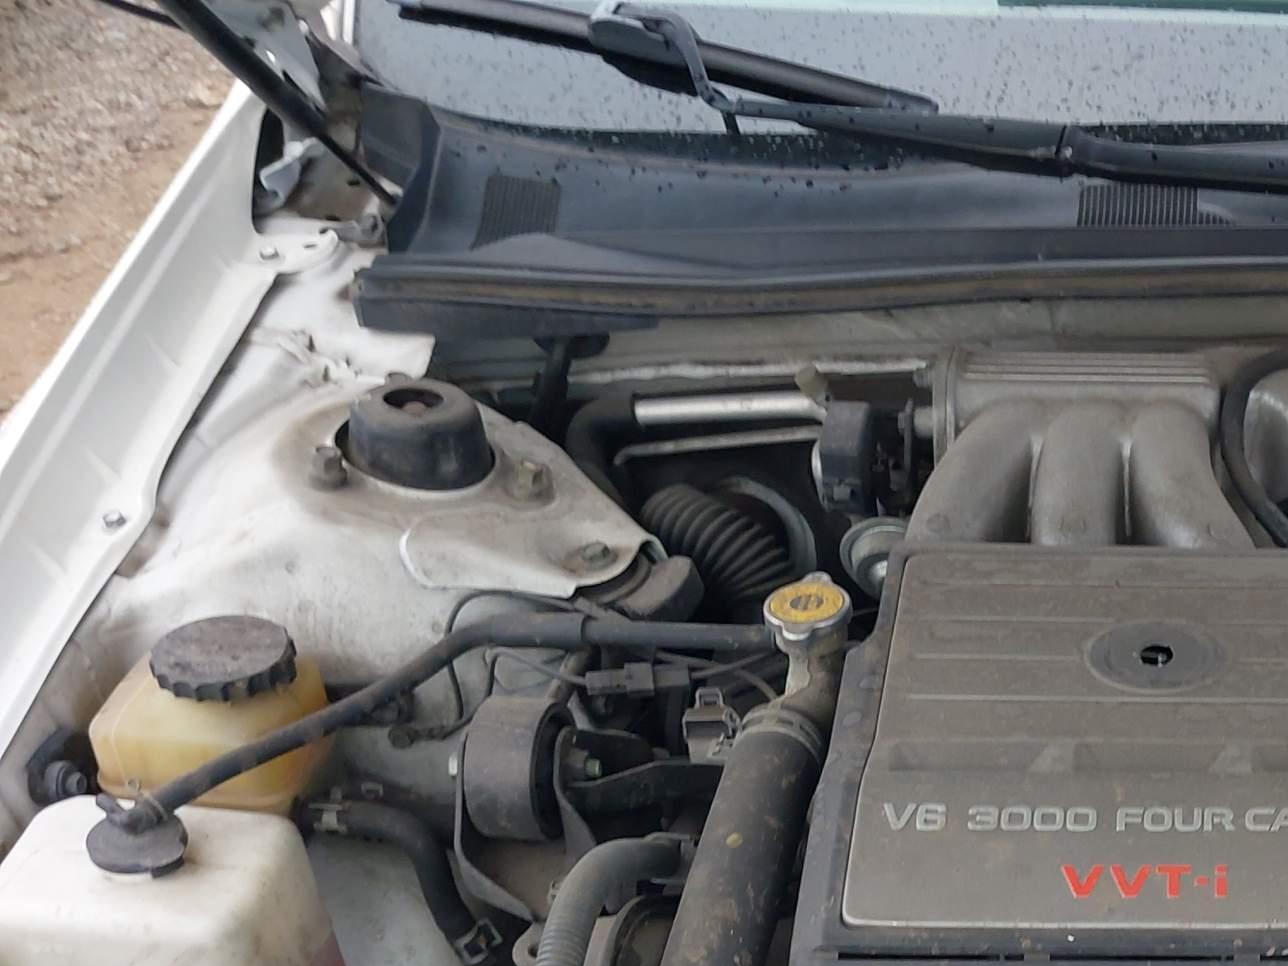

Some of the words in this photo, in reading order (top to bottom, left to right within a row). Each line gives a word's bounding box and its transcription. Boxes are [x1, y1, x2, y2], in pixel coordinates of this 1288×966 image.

[882, 802, 948, 832] V6
[966, 805, 1098, 832] 3000
[1115, 806, 1236, 832] FOUR
